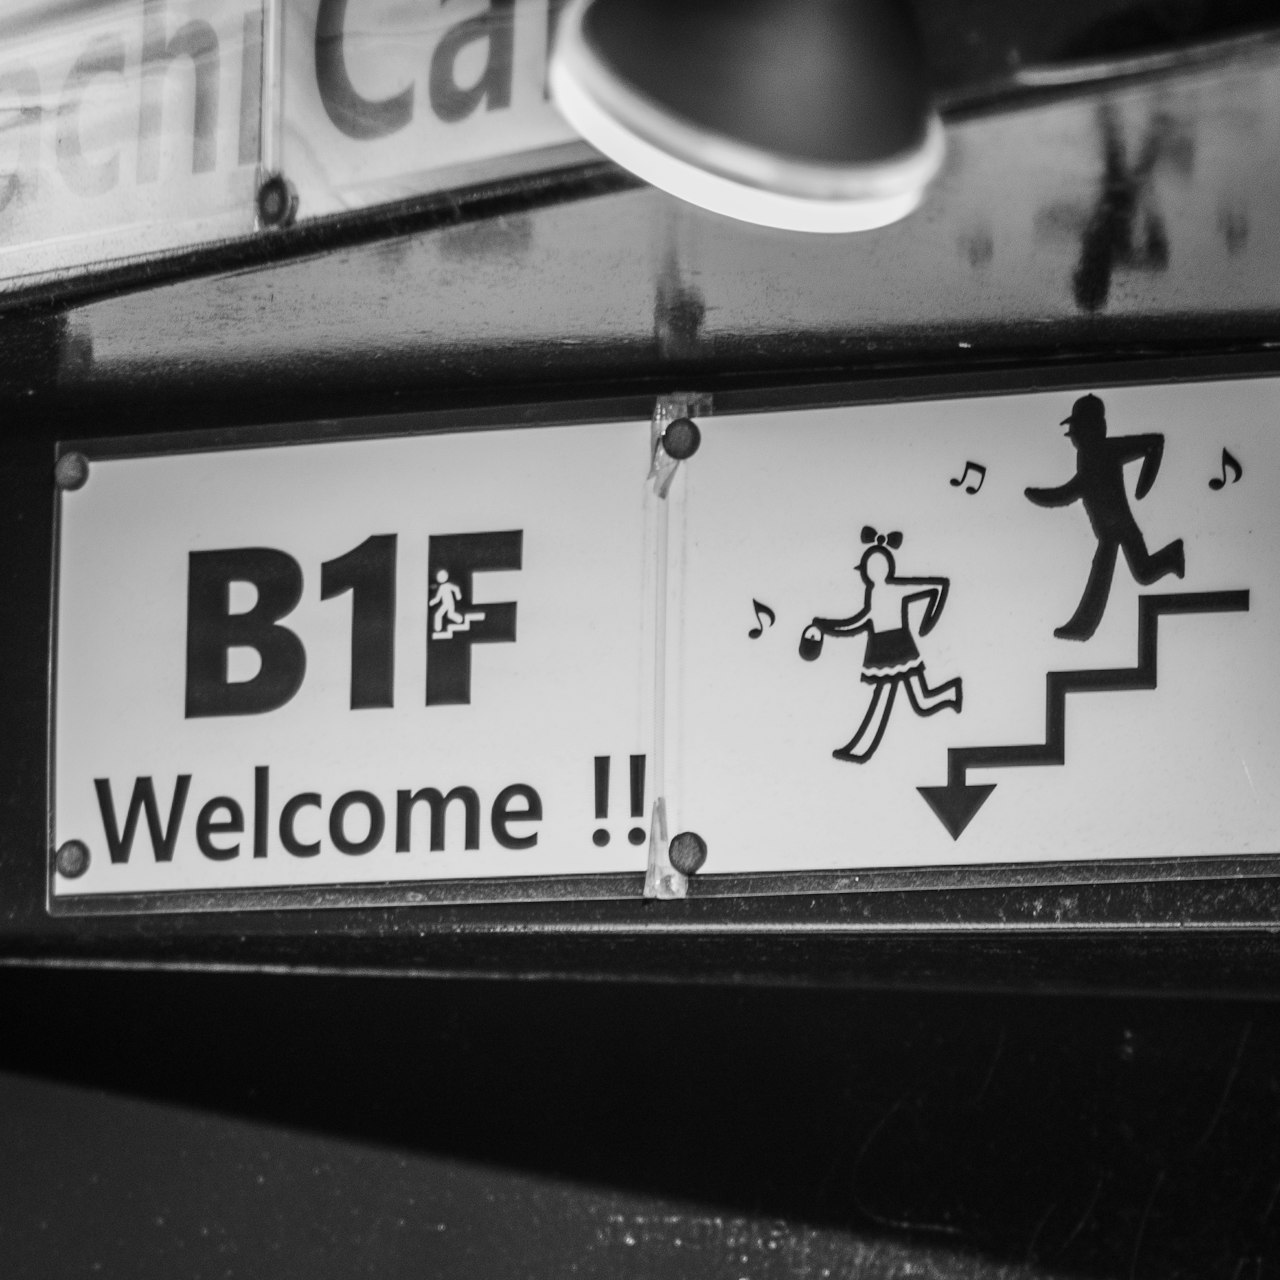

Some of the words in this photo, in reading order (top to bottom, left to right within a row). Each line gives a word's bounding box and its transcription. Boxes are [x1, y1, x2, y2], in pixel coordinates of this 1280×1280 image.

[314, 0, 554, 141] Ca
[184, 528, 524, 720] B1F
[92, 766, 543, 864] Welcome
